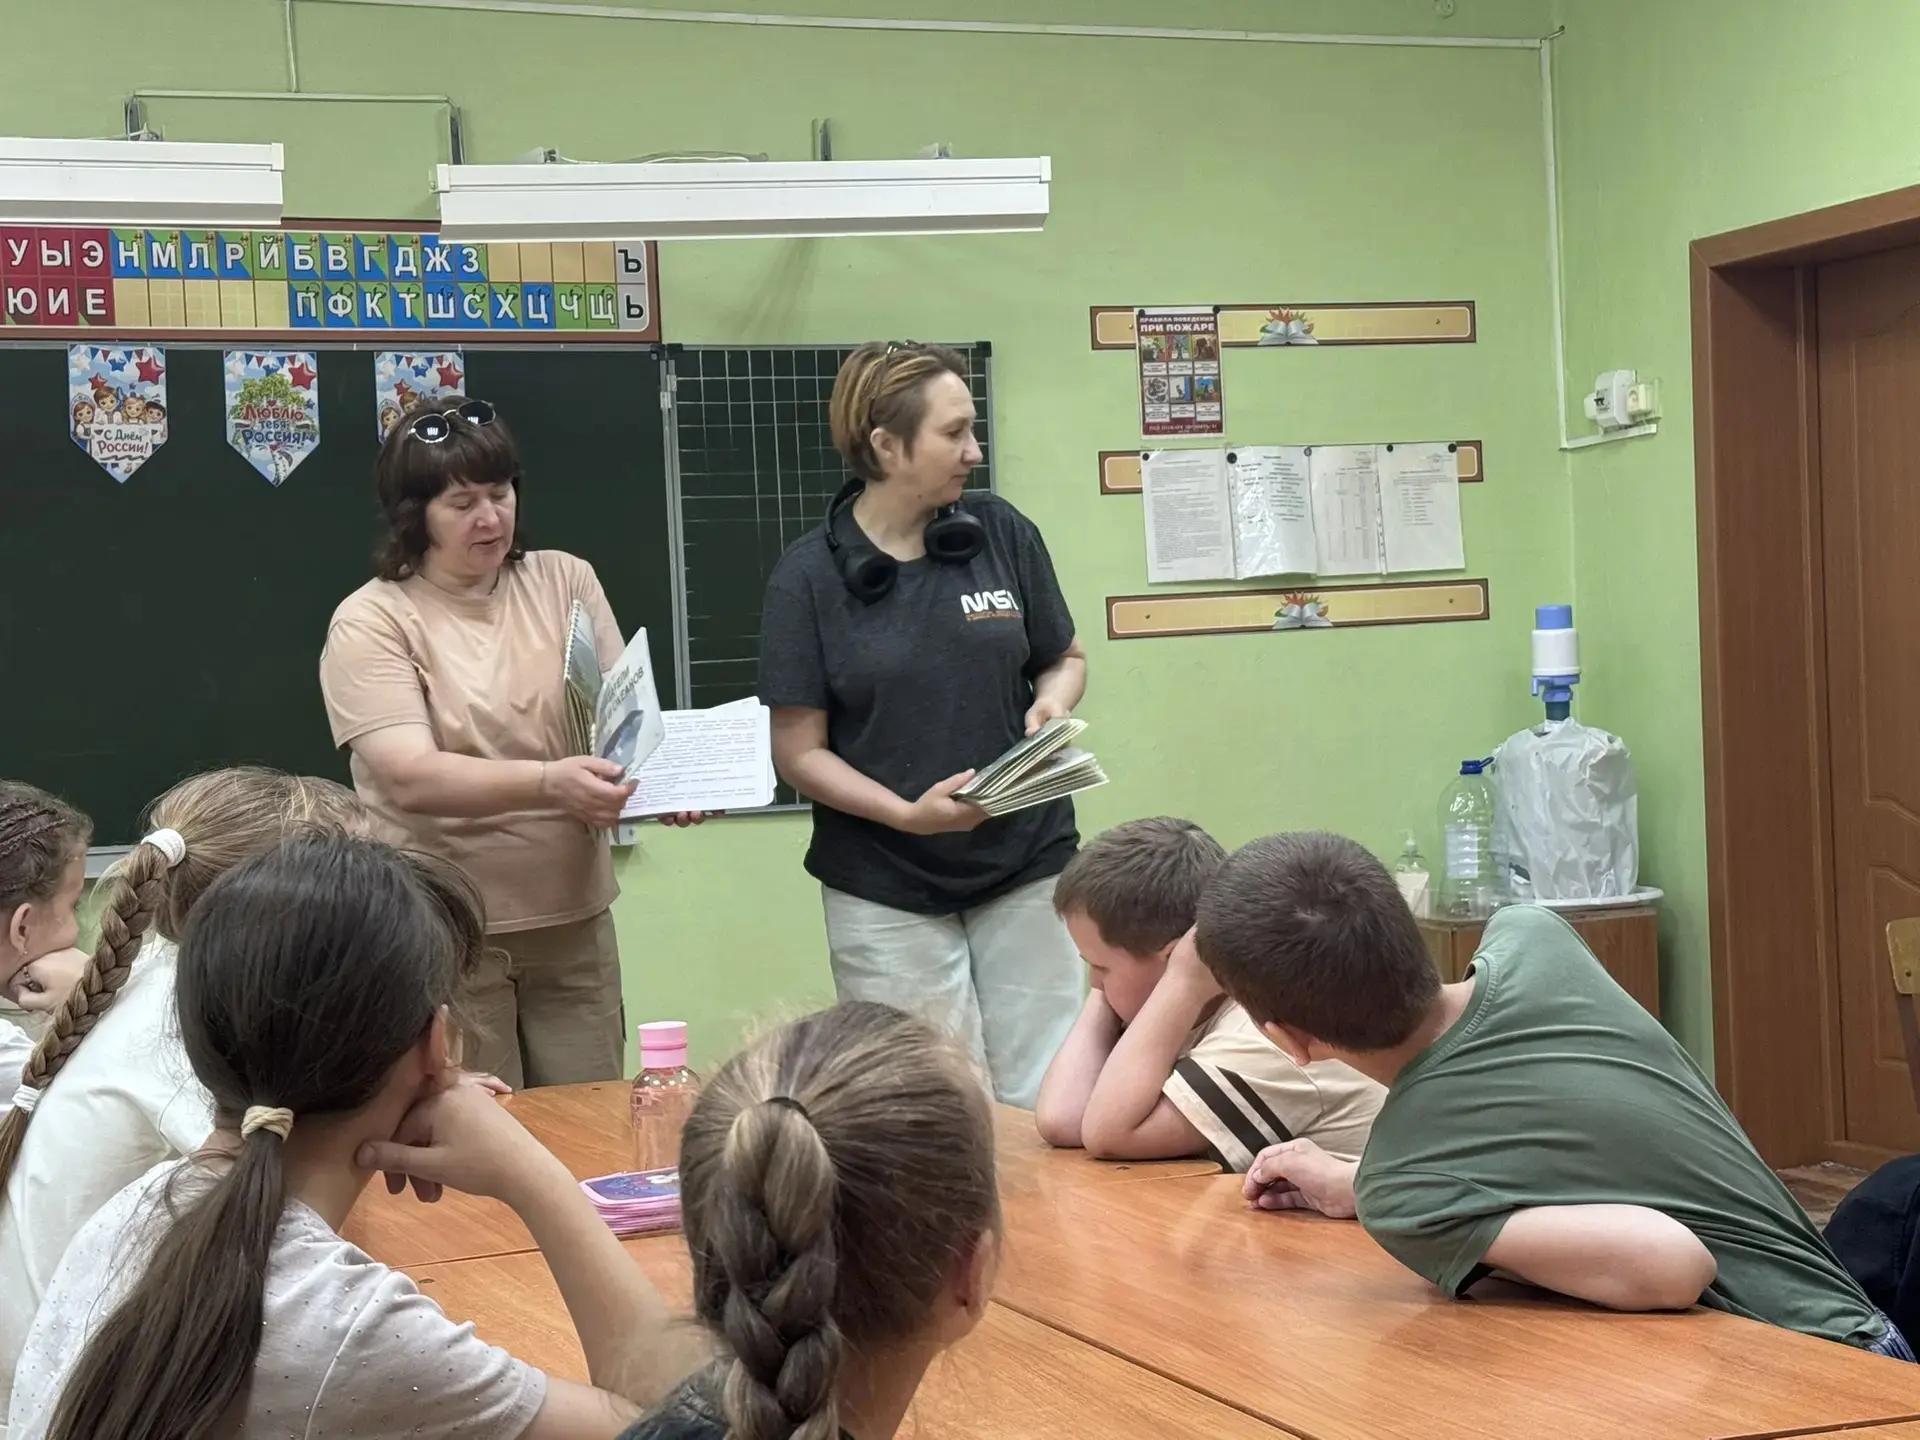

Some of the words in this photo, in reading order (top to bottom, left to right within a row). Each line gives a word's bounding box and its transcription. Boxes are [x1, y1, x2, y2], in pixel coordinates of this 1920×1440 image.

[8, 239, 28, 265] У
[41, 240, 71, 266] Ы
[82, 240, 103, 267] Э
[118, 241, 139, 267] Н
[152, 242, 177, 268] М
[189, 243, 209, 268] Л
[225, 244, 244, 269] Р
[260, 236, 280, 269] Й
[294, 245, 314, 270] Б
[328, 245, 348, 270] В
[363, 246, 380, 270] Г
[395, 247, 418, 275] Д
[424, 247, 451, 272] Ж
[461, 247, 479, 273] З
[618, 250, 641, 272] Ъ
[8, 287, 37, 314] Ю
[48, 288, 69, 314] И
[86, 289, 106, 314] Е
[297, 292, 316, 317] П
[328, 292, 352, 316] Ф
[366, 293, 384, 317] К
[399, 293, 417, 318] Т
[428, 293, 454, 318] Ш
[463, 294, 483, 318] С
[497, 294, 516, 318] Х
[528, 294, 548, 323] Ц
[560, 295, 579, 318] Ч
[591, 295, 615, 323] Щ
[626, 295, 643, 318] Ь
[1140, 324, 1164, 332] ПРИ
[1166, 323, 1215, 332] ПОЖАРЕ
[115, 429, 142, 441] Днём
